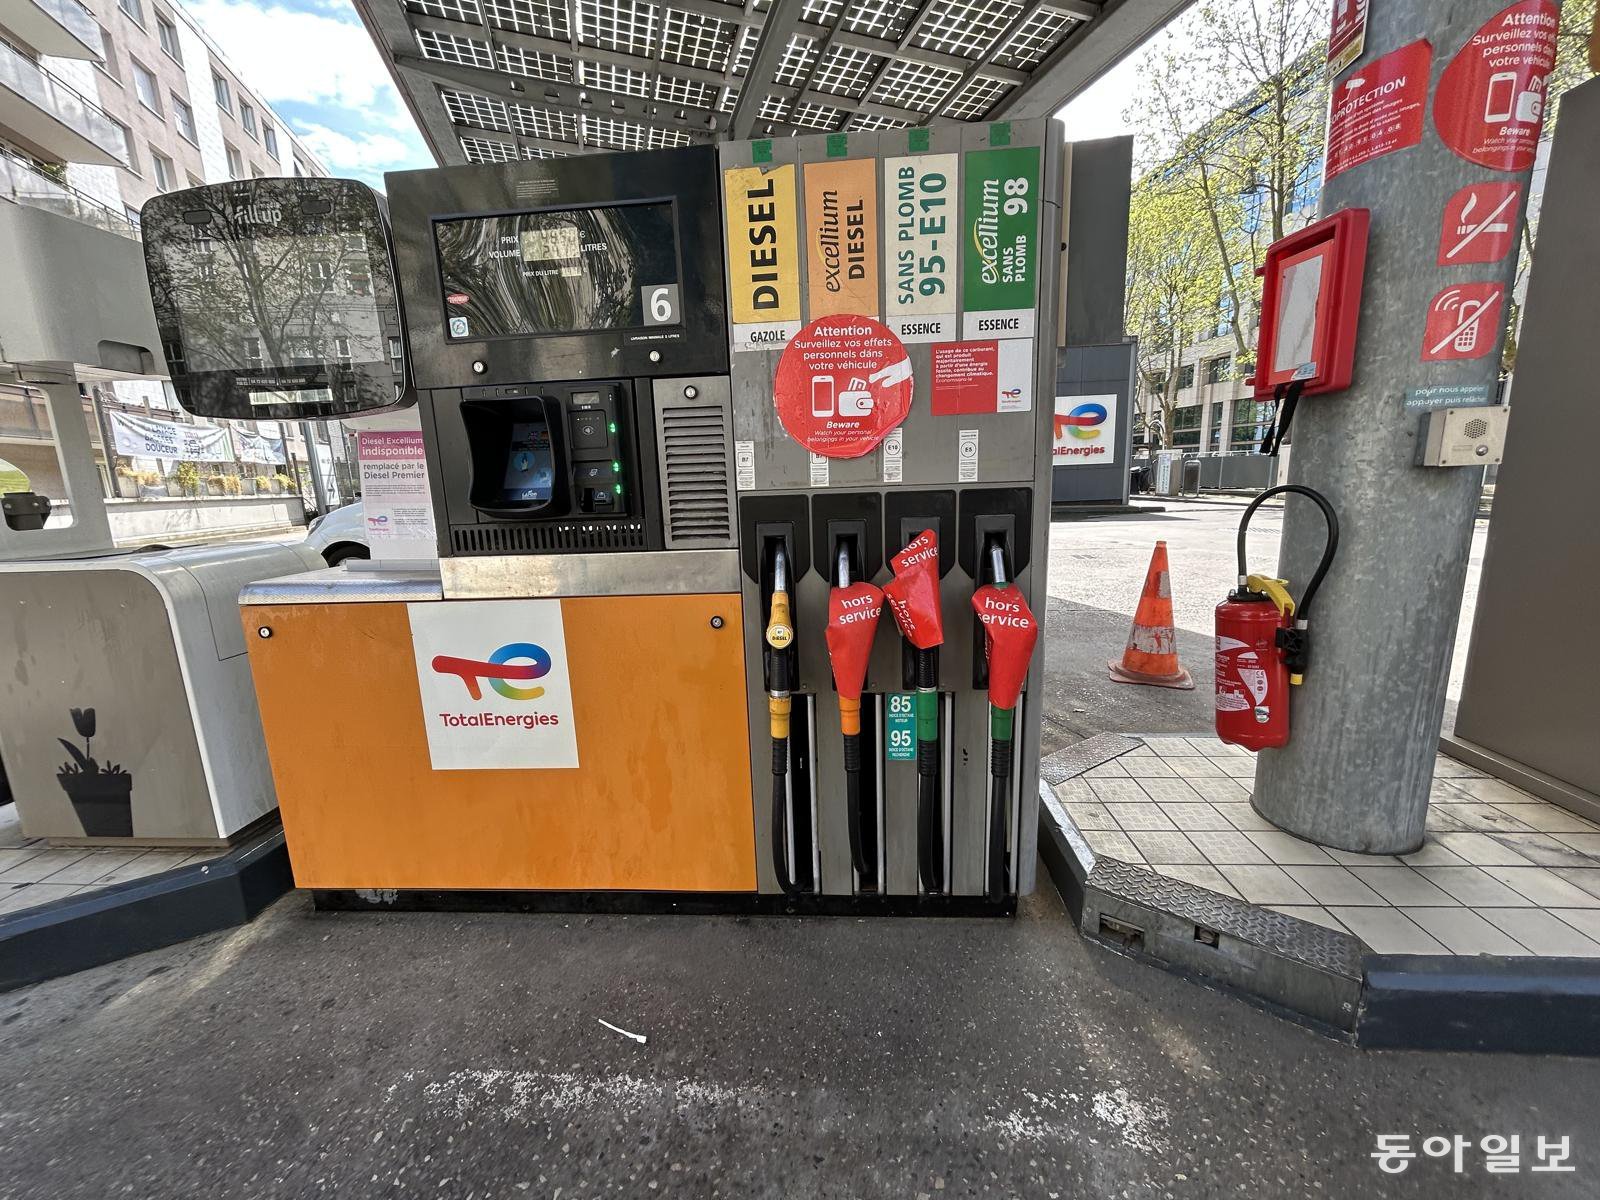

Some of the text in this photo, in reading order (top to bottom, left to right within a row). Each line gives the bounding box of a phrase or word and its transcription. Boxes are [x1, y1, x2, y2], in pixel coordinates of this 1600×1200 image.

[1472, 28, 1532, 46] Surveillez
[1482, 42, 1542, 58] personnels
[1489, 56, 1520, 67] votre
[1500, 126, 1530, 136] Beware
[1004, 176, 1029, 216] 98
[898, 166, 915, 304] SANS PLOMB
[919, 172, 947, 297] 95-E10
[977, 178, 1000, 285] excellium
[501, 236, 519, 244] PRIX
[748, 178, 779, 310] DIESEL
[820, 190, 840, 294] excellium
[846, 199, 865, 280] DIESEL
[489, 250, 520, 258] VOLUME
[581, 243, 607, 252] LITRES
[1003, 246, 1013, 282] SANS
[1015, 234, 1026, 282] PLOMB
[651, 288, 672, 321] 6
[814, 326, 872, 336] Attention
[901, 323, 941, 336] ESSENCE
[978, 318, 1019, 331] ESSENCE
[750, 330, 786, 342] GAZOLE
[794, 340, 841, 349] Surveillez
[864, 338, 892, 347] effets
[804, 349, 883, 360] personnels dans
[837, 360, 877, 369] véhicule
[1415, 387, 1437, 397] pour
[145, 443, 178, 454] DOUCEUR
[362, 437, 385, 445] Diesel
[362, 446, 423, 456] indisponible
[364, 462, 400, 471] remplacé
[364, 471, 389, 479] Diesel
[900, 536, 929, 554] hors
[901, 547, 938, 568] service
[841, 593, 873, 610] hors
[985, 597, 1020, 612] hors
[839, 606, 882, 625] service
[890, 696, 911, 712] 85
[439, 711, 559, 729] TotalEnergies
[891, 730, 911, 746] 95
